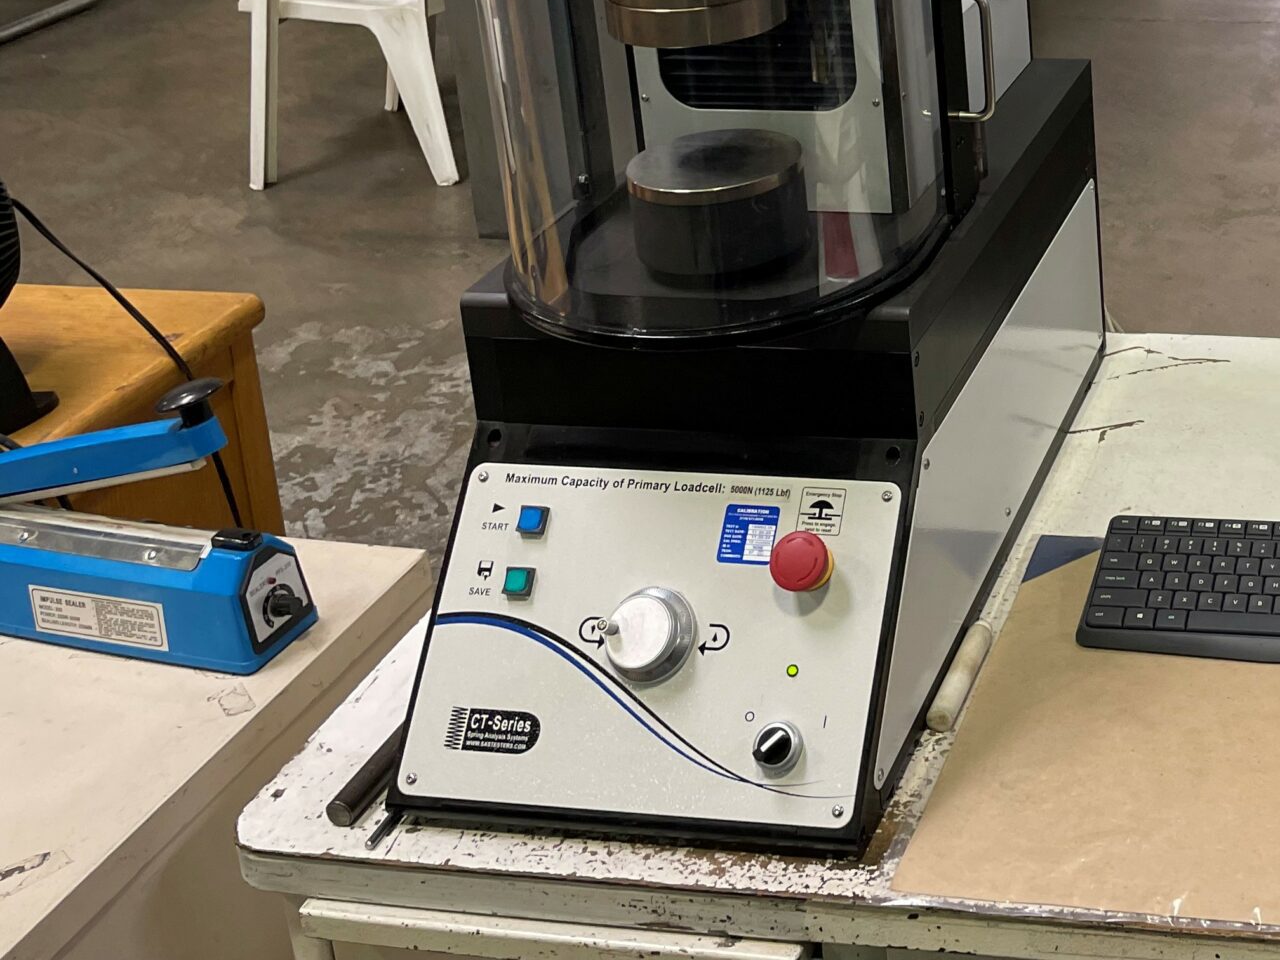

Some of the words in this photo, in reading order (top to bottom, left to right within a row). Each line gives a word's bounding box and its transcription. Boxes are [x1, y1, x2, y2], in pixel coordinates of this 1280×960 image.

[505, 473, 557, 486] Maximum
[561, 475, 609, 490] Capacity
[613, 478, 626, 488] of
[627, 479, 671, 493] Primary
[674, 481, 726, 494] Loadcell:
[730, 486, 753, 495] 5000N
[755, 486, 774, 497] (1125
[776, 487, 791, 499] Lbf)
[482, 522, 509, 531] START
[469, 587, 491, 596] SAVE
[40, 596, 62, 605] IMPULSE
[65, 599, 86, 608] SEALER
[470, 713, 532, 733] CT-Series
[467, 731, 484, 740] Spring
[485, 732, 506, 741] Analysis
[507, 733, 529, 743] Systems
